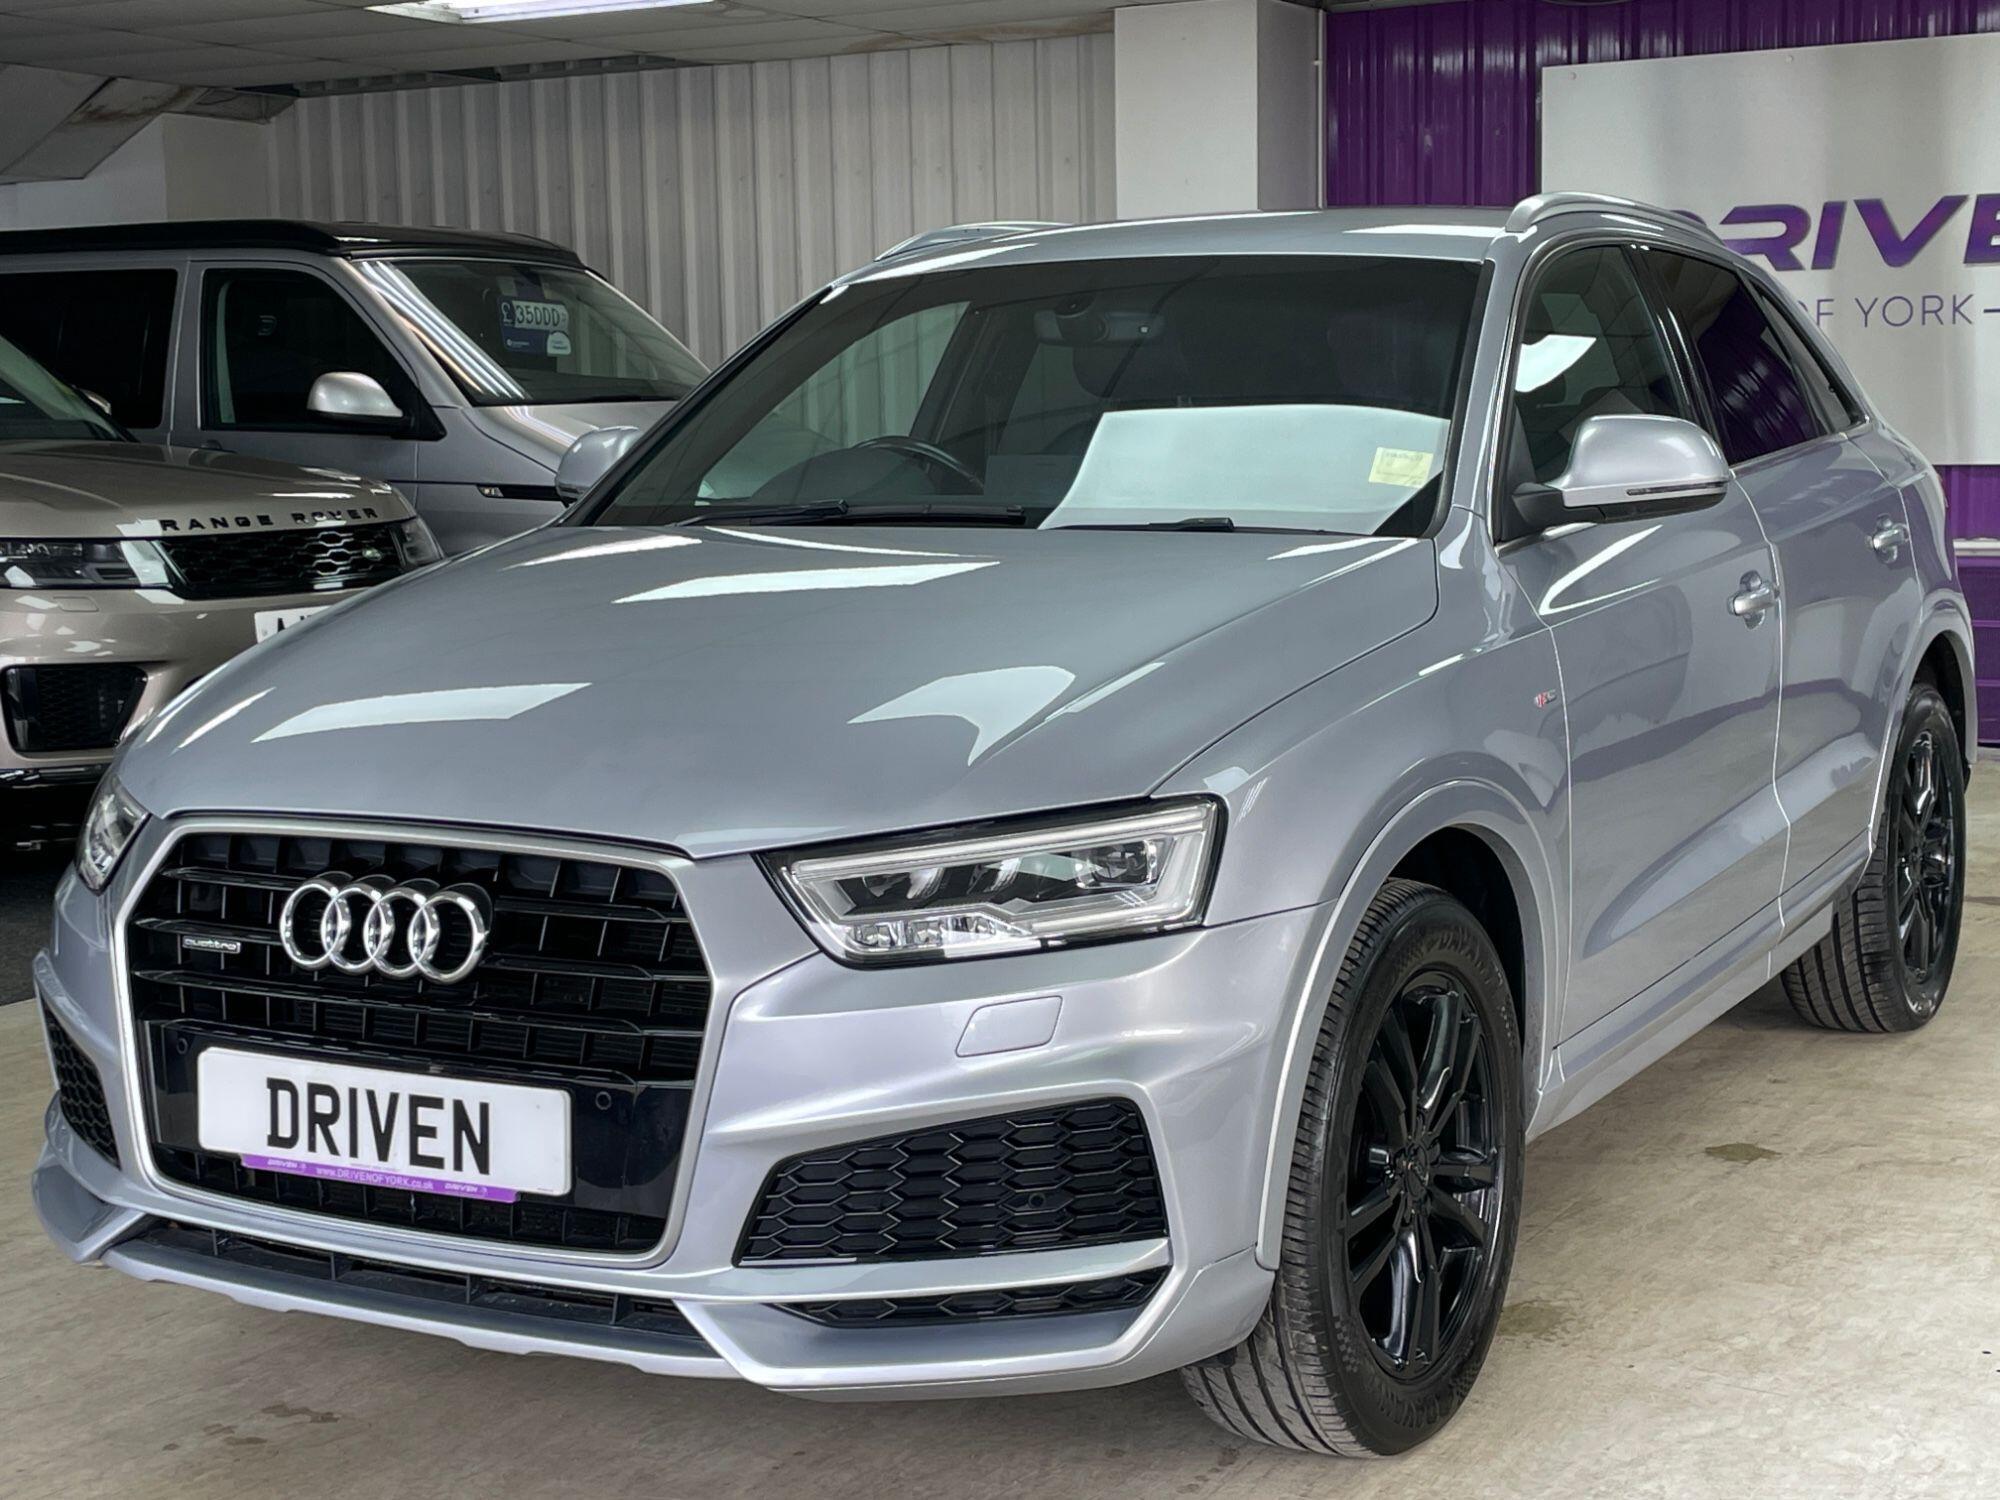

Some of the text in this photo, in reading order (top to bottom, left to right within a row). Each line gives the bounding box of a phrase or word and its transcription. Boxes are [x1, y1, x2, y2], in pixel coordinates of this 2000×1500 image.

[1671, 194, 2000, 272] RIV
[1797, 294, 1975, 328] F YORK
[159, 507, 379, 531] RANGE ROVER
[266, 1076, 491, 1176] DRIVEN
